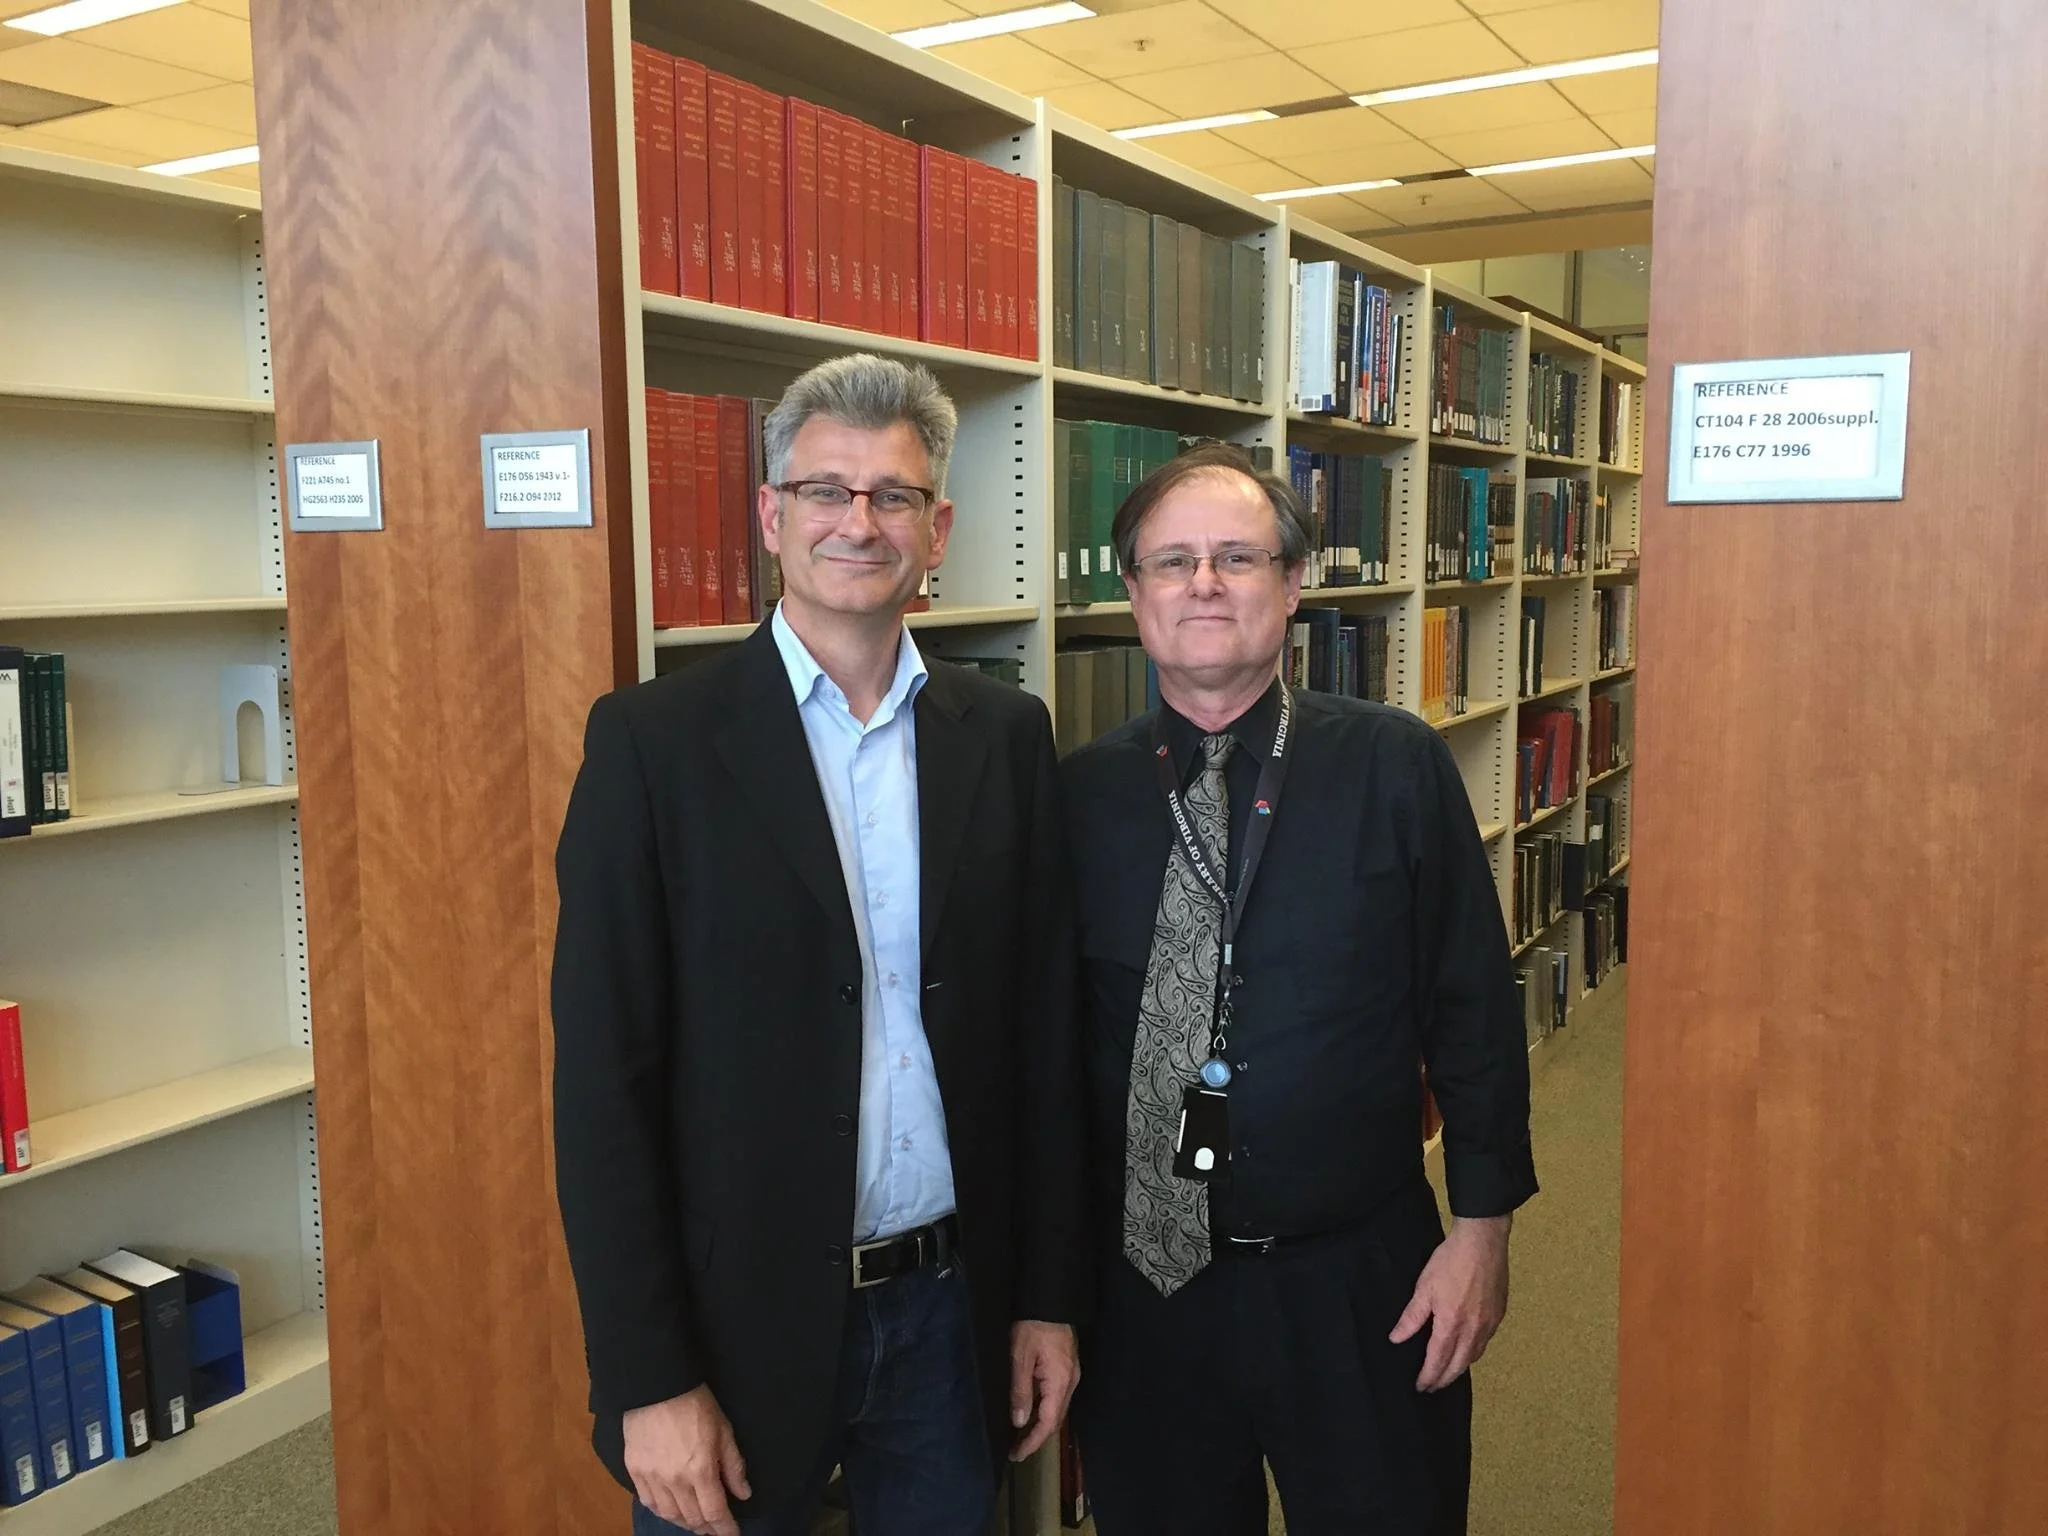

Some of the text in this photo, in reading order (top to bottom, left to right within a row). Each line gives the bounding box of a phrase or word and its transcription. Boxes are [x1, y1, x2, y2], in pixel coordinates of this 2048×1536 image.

[1697, 382, 1789, 398] REFERENCE
[1695, 410, 1879, 429] CT104 F 28 2006suppl.
[497, 451, 541, 461] REFERENCE
[1693, 443, 1811, 459] E176 C77 1996
[300, 456, 336, 466] REFERENCE
[301, 475, 316, 485] F221
[498, 472, 517, 481] E176
[535, 471, 554, 481] 1943
[347, 494, 364, 504] 2005
[499, 492, 524, 502] F216.2
[543, 492, 562, 501] 2012
[1272, 708, 1290, 758] VIRGINIA
[1168, 789, 1194, 845] VIRGINIA
[1187, 845, 1201, 861] OF
